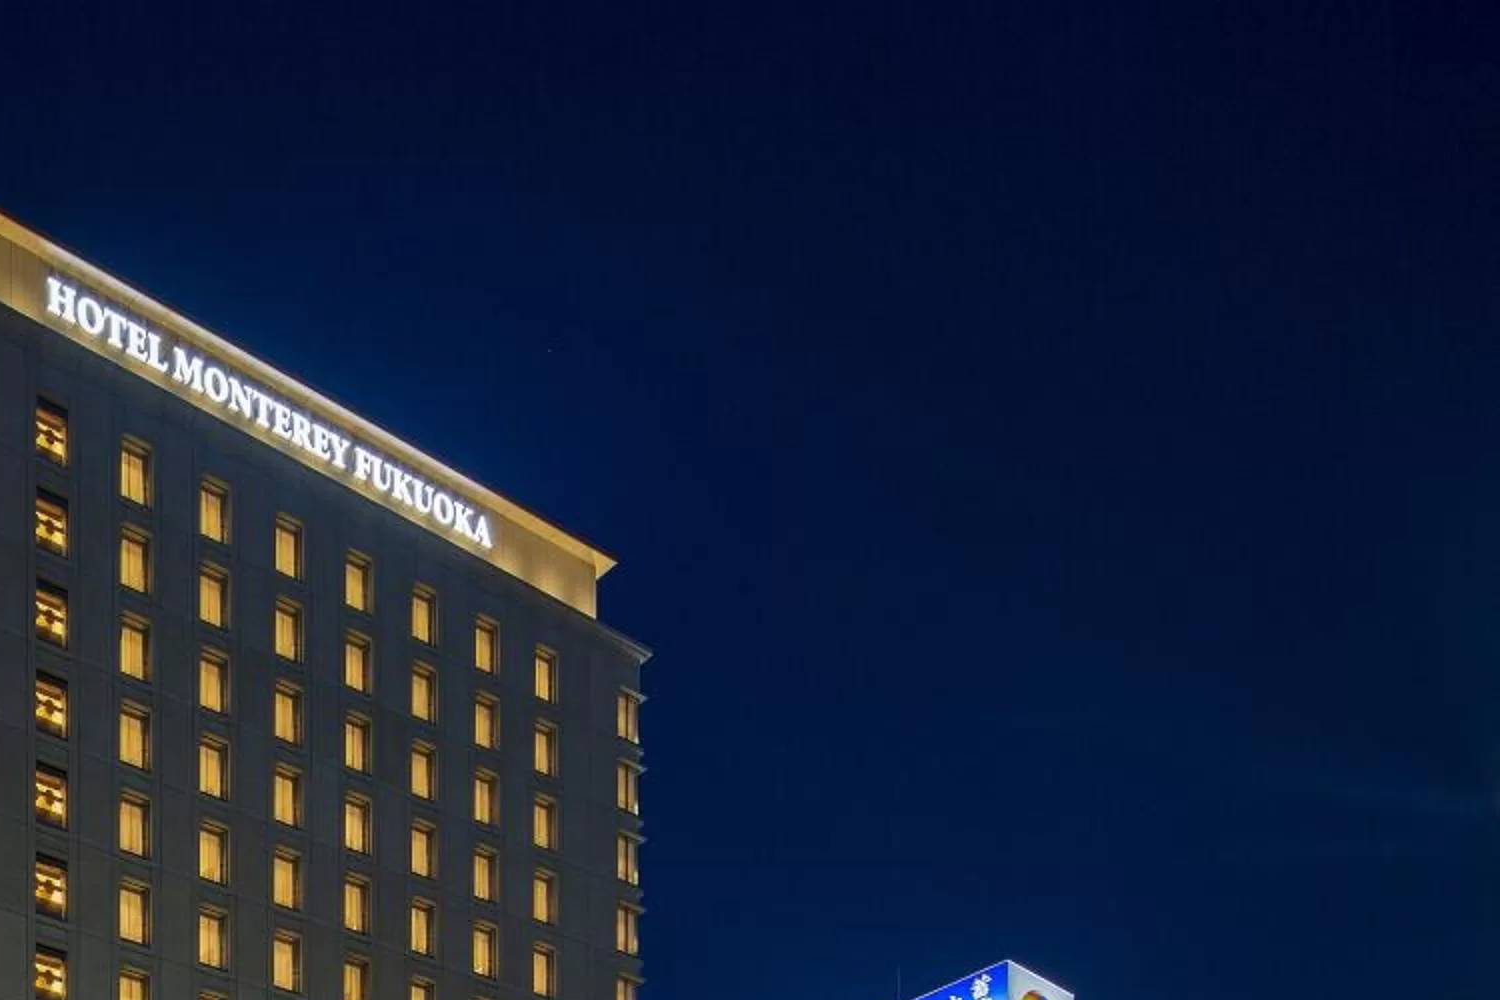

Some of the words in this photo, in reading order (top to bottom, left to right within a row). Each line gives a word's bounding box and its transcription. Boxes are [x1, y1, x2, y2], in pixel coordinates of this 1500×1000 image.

[46, 277, 168, 372] HOTEL
[172, 345, 353, 468] MONTEREY
[353, 442, 493, 549] FUKUOKA
